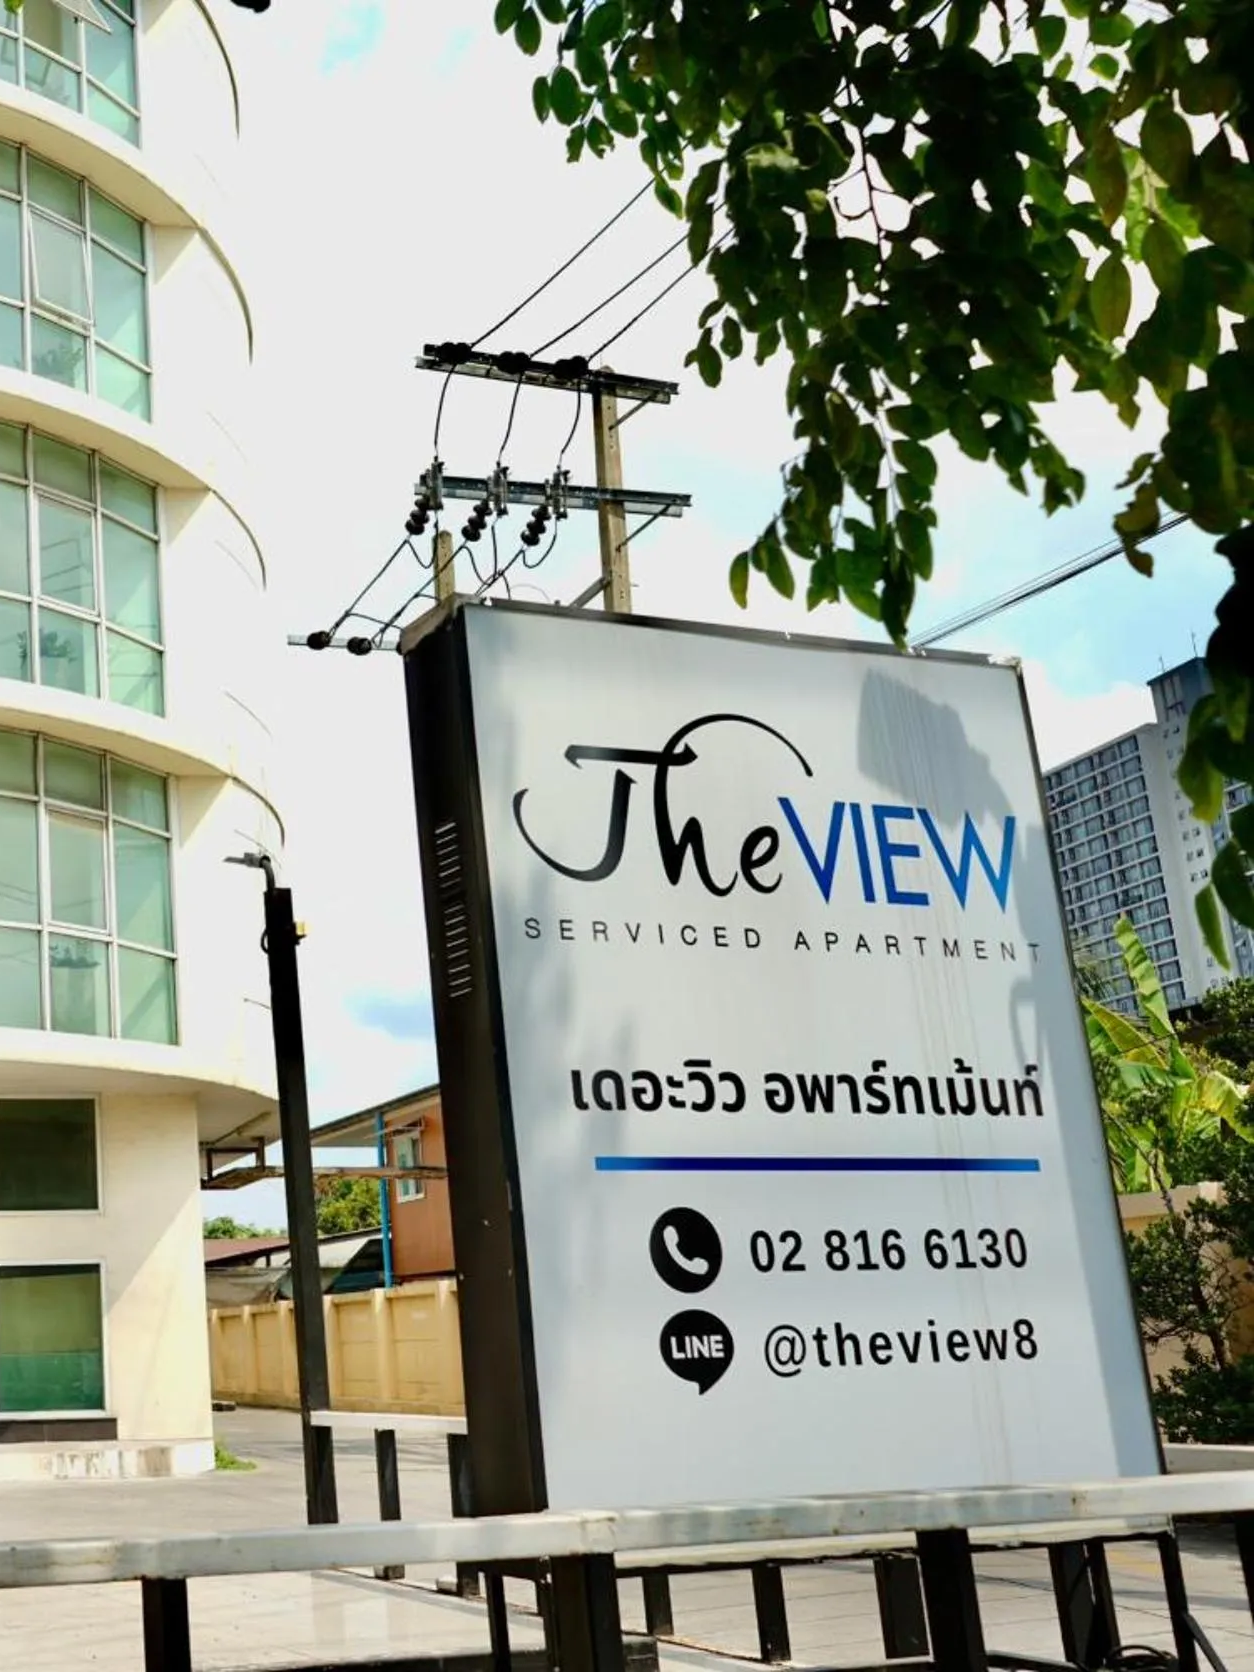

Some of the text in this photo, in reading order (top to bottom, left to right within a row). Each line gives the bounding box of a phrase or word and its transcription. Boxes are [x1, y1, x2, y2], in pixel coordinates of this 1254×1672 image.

[523, 917, 1041, 963] SERVICED APARTMENT
[570, 1058, 1044, 1117] เดอะวิว อพาร์ทเม้นท์
[749, 1228, 1028, 1273] 02 816 6130
[670, 1334, 725, 1360] LINE
[764, 1319, 1038, 1378] @theview8
